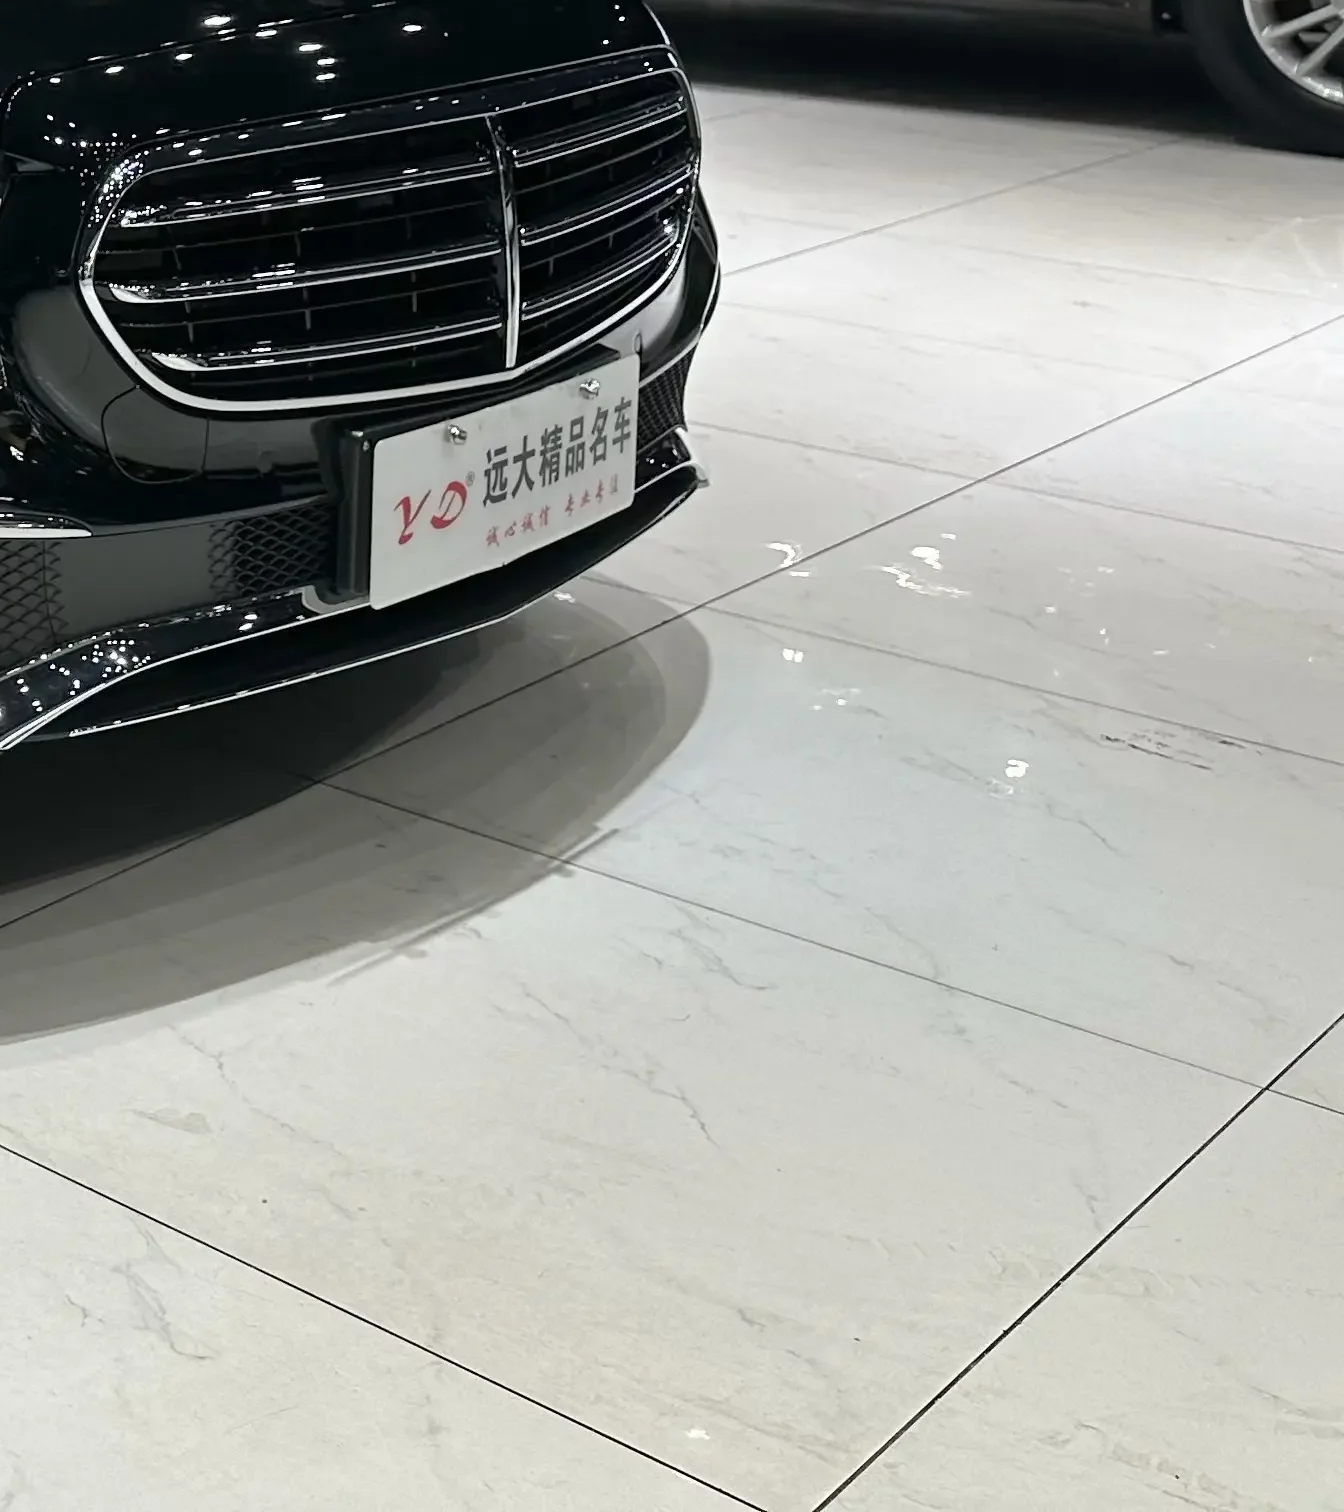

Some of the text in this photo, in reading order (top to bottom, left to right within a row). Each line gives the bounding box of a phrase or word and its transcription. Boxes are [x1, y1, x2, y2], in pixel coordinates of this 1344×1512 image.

[482, 396, 632, 507] 远大精品名车
